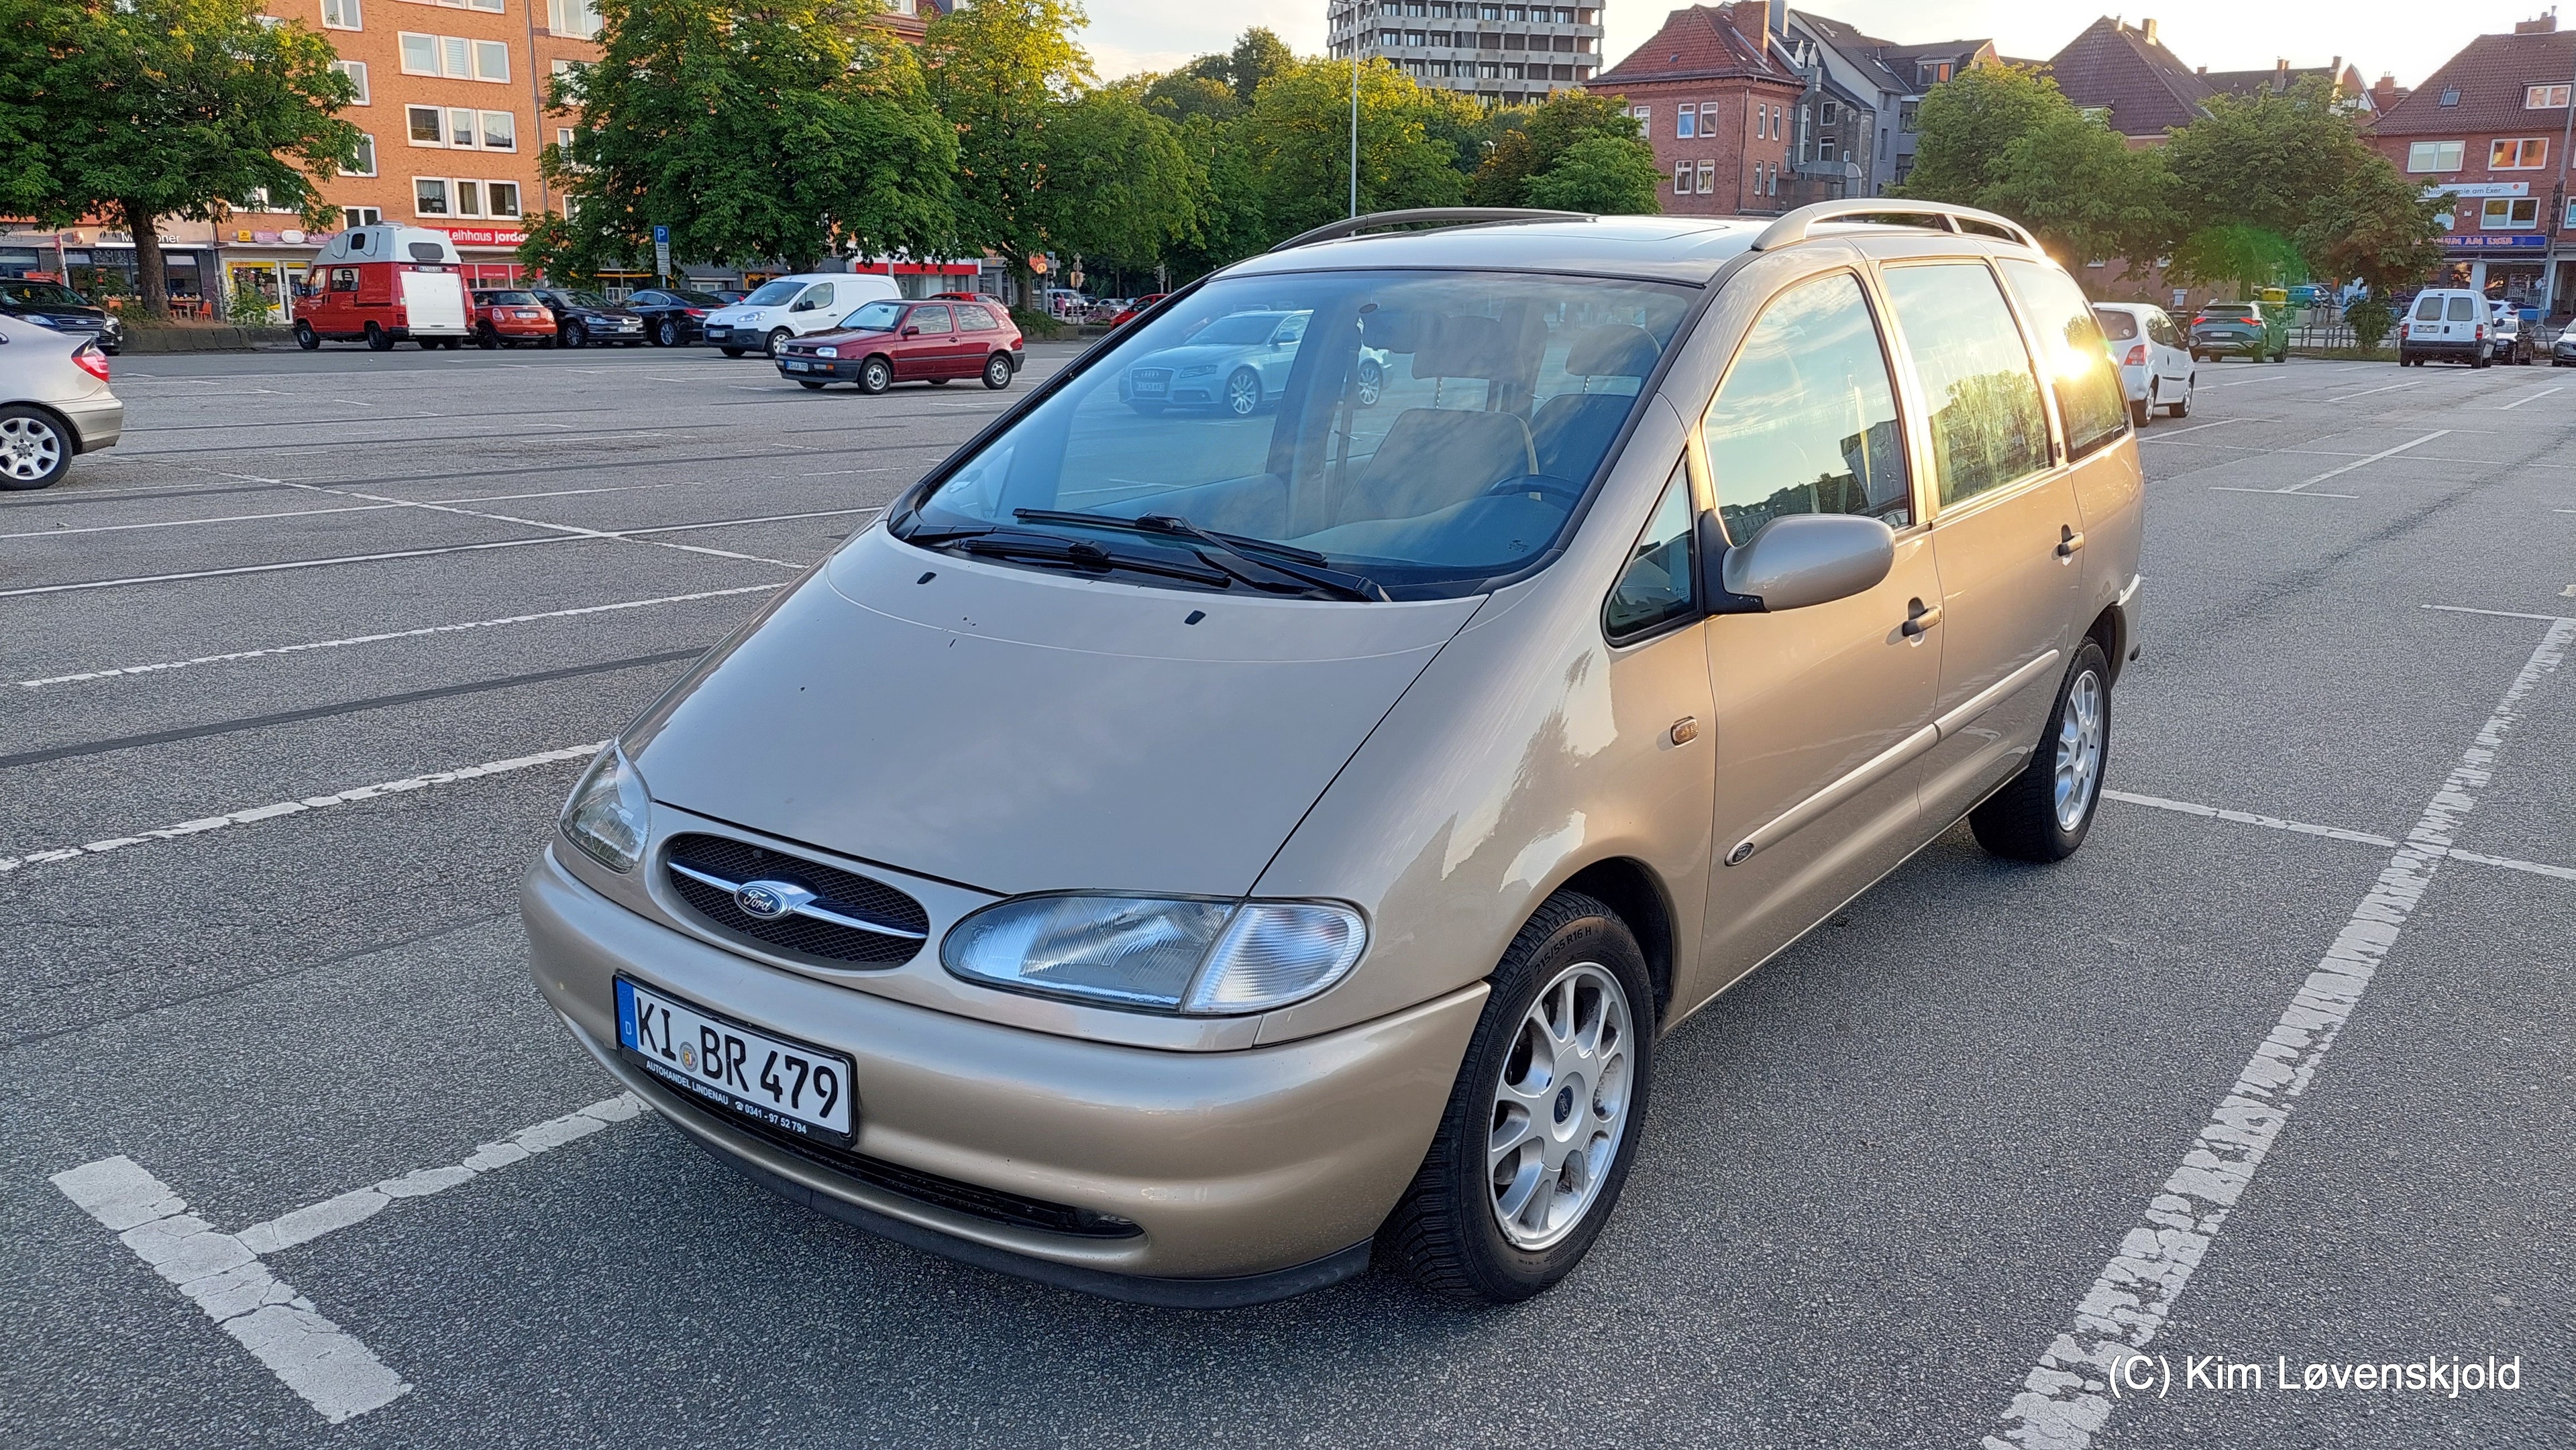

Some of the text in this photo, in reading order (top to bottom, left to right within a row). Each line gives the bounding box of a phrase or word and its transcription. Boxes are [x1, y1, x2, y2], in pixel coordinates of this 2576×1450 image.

[2423, 186, 2470, 196] siothepie
[2485, 186, 2502, 194] Exer
[446, 229, 492, 242] Leihhaus
[657, 228, 665, 241] P
[2465, 237, 2483, 245] AM
[743, 889, 773, 911] Ford
[1534, 926, 1592, 975] 215/55 R16 H
[625, 996, 839, 1119] D KI BR 479
[646, 1060, 692, 1089] AUTOHANDEL
[692, 1082, 729, 1105] LINDENAU
[745, 1104, 763, 1119] 0341
[769, 1113, 779, 1125] 97
[780, 1117, 791, 1129] 52
[792, 1121, 807, 1135] 794
